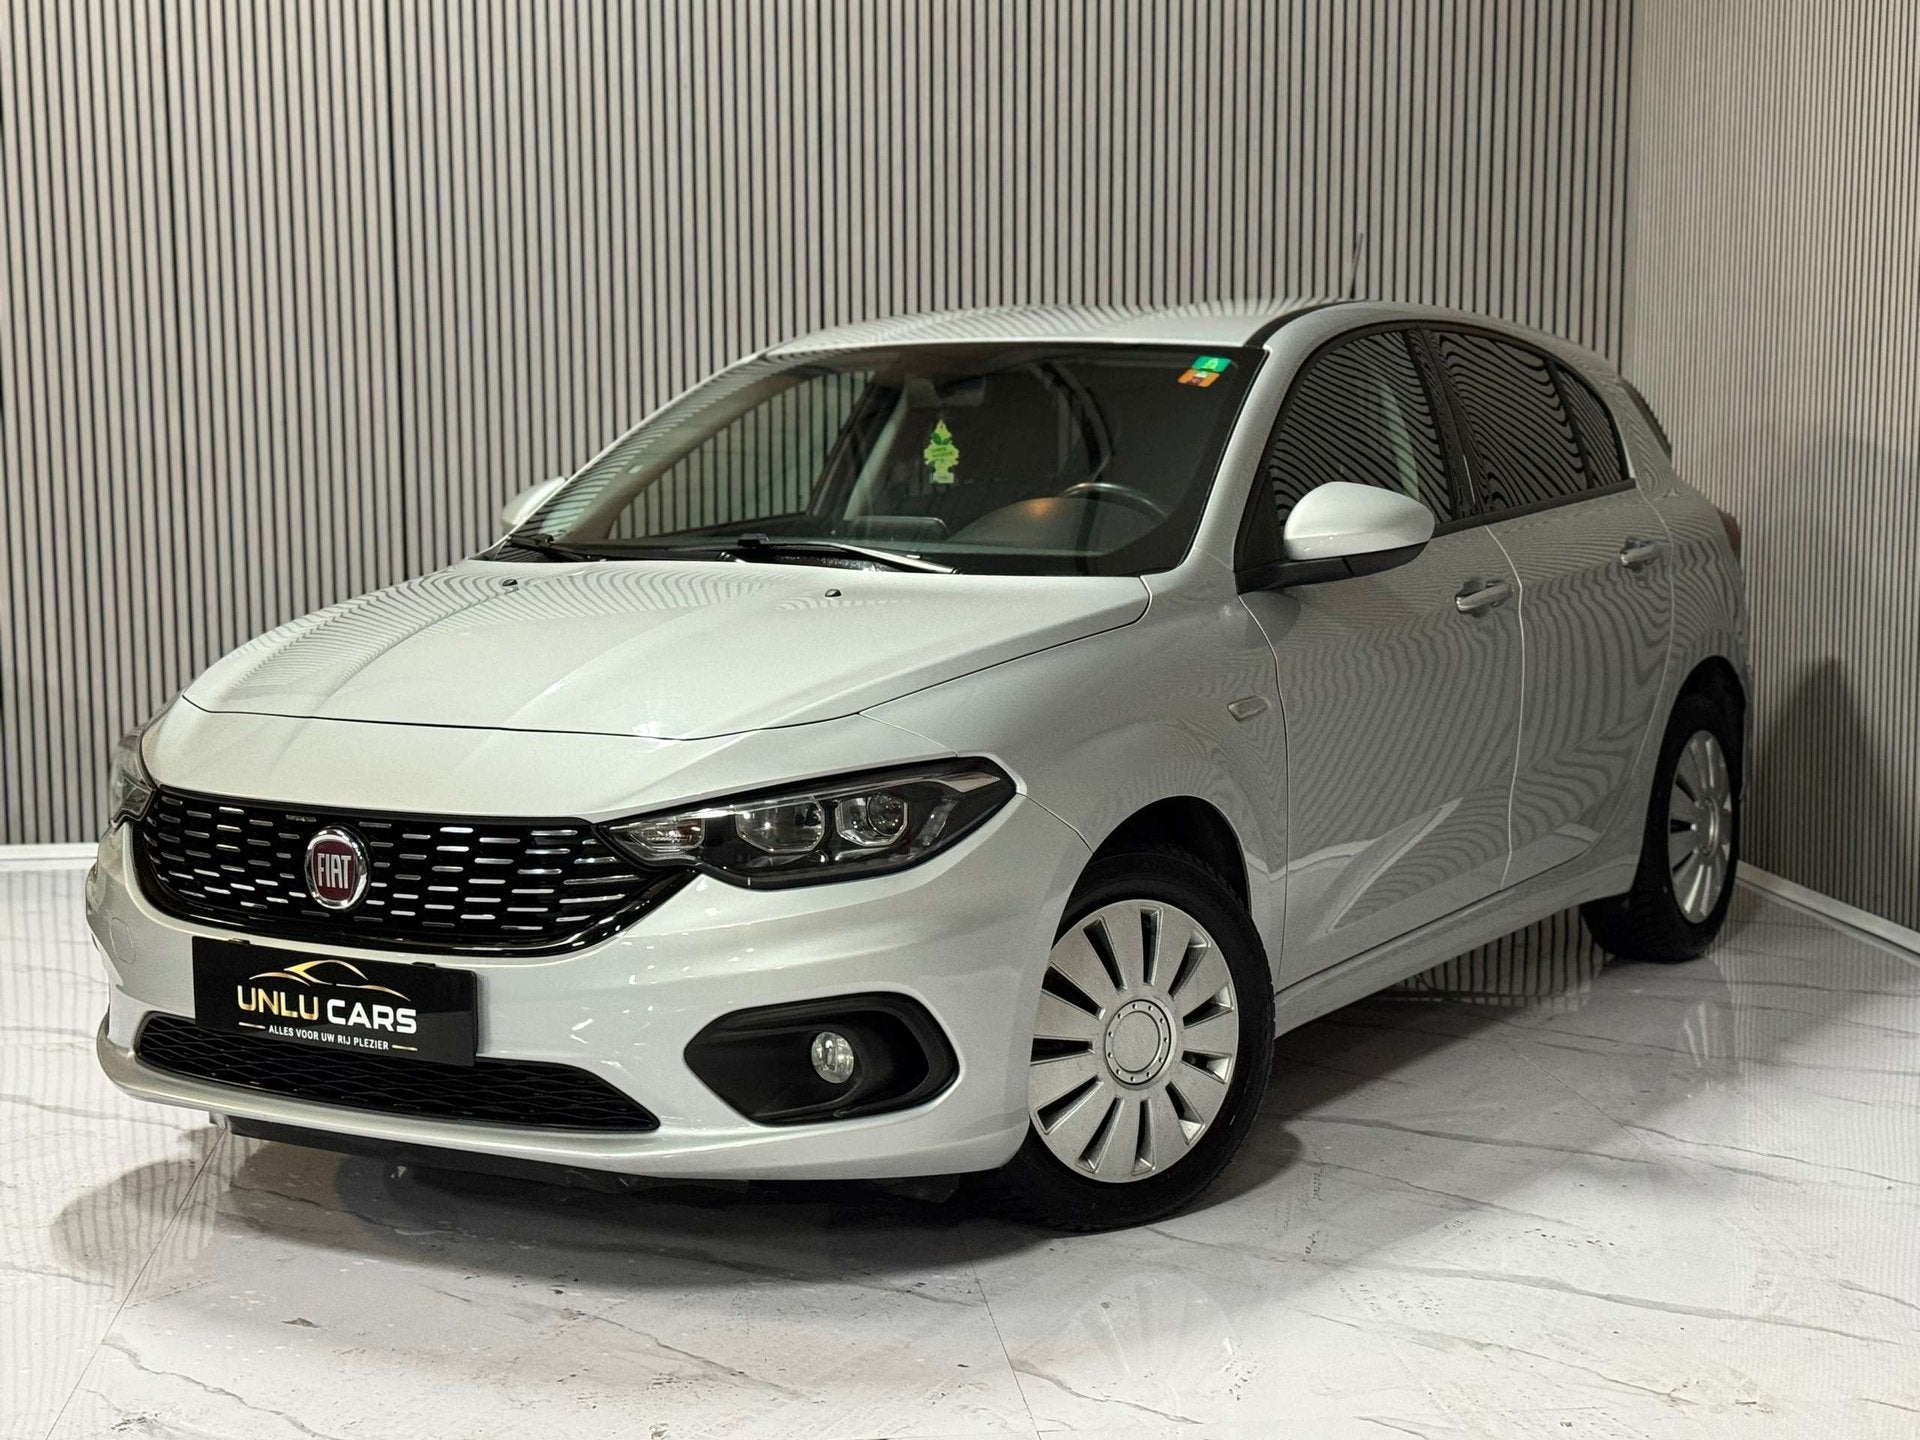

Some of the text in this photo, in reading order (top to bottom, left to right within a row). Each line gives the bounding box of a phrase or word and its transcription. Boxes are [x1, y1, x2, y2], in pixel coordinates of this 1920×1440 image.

[317, 853, 352, 889] FIAT
[237, 985, 417, 1034] UNLU CARS
[268, 1024, 389, 1050] ALLES VOOR UW RIJ PLEZIER
